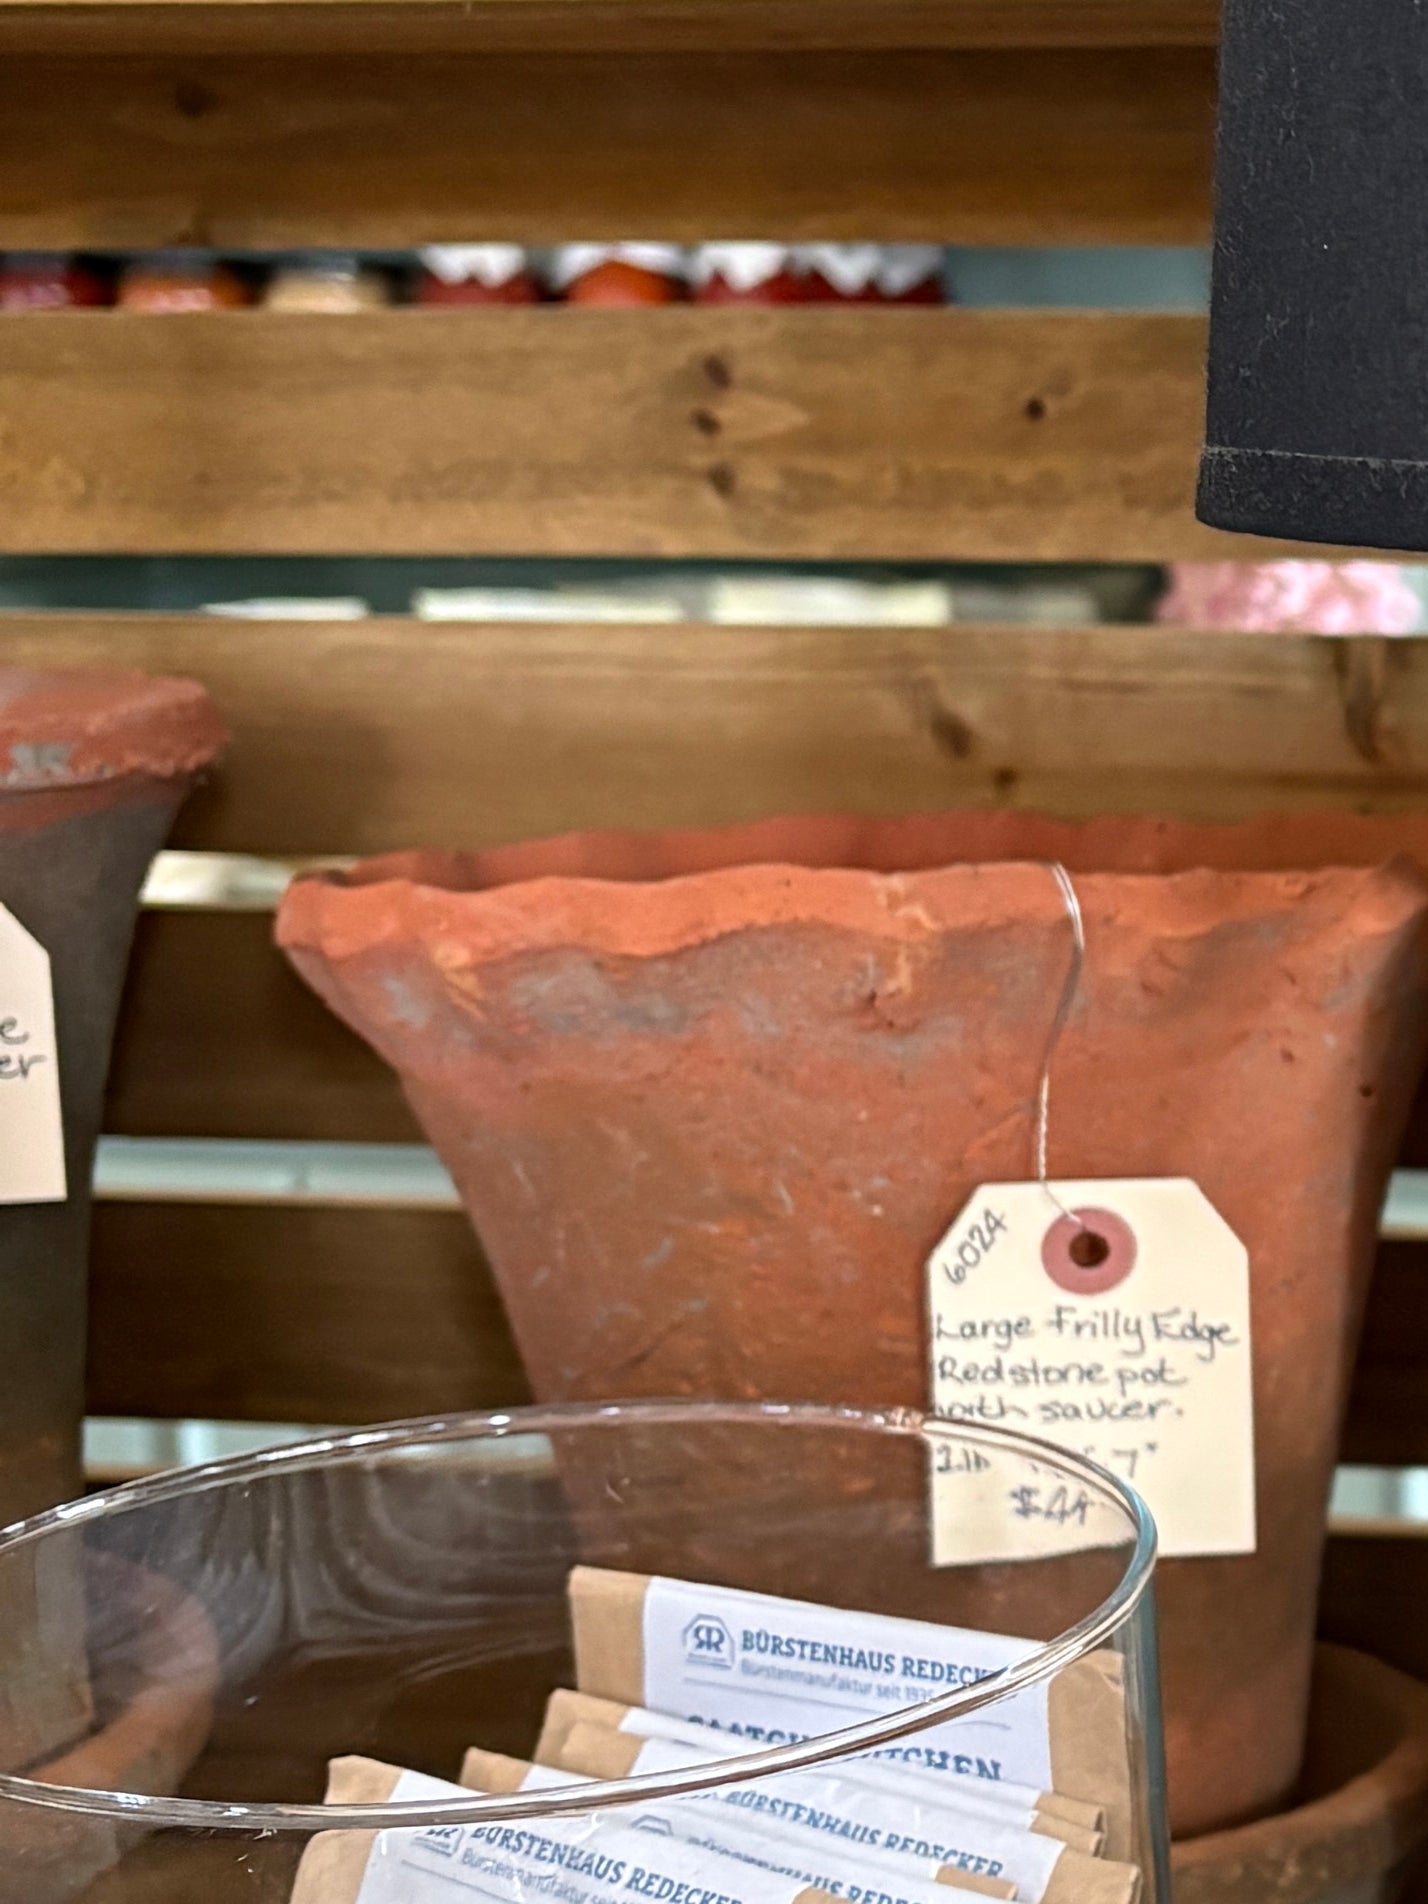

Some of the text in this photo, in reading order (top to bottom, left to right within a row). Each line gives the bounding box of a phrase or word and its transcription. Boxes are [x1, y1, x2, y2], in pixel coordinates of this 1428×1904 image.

[936, 1304, 1241, 1363] Large Frilly Edge
[1117, 1359, 1189, 1397] pot
[741, 1627, 896, 1676] BÜRSTENHAUS
[740, 1658, 874, 1698] Bürstenmanufaktur
[876, 1681, 902, 1702] seit
[884, 1831, 1005, 1880] REDECKER
